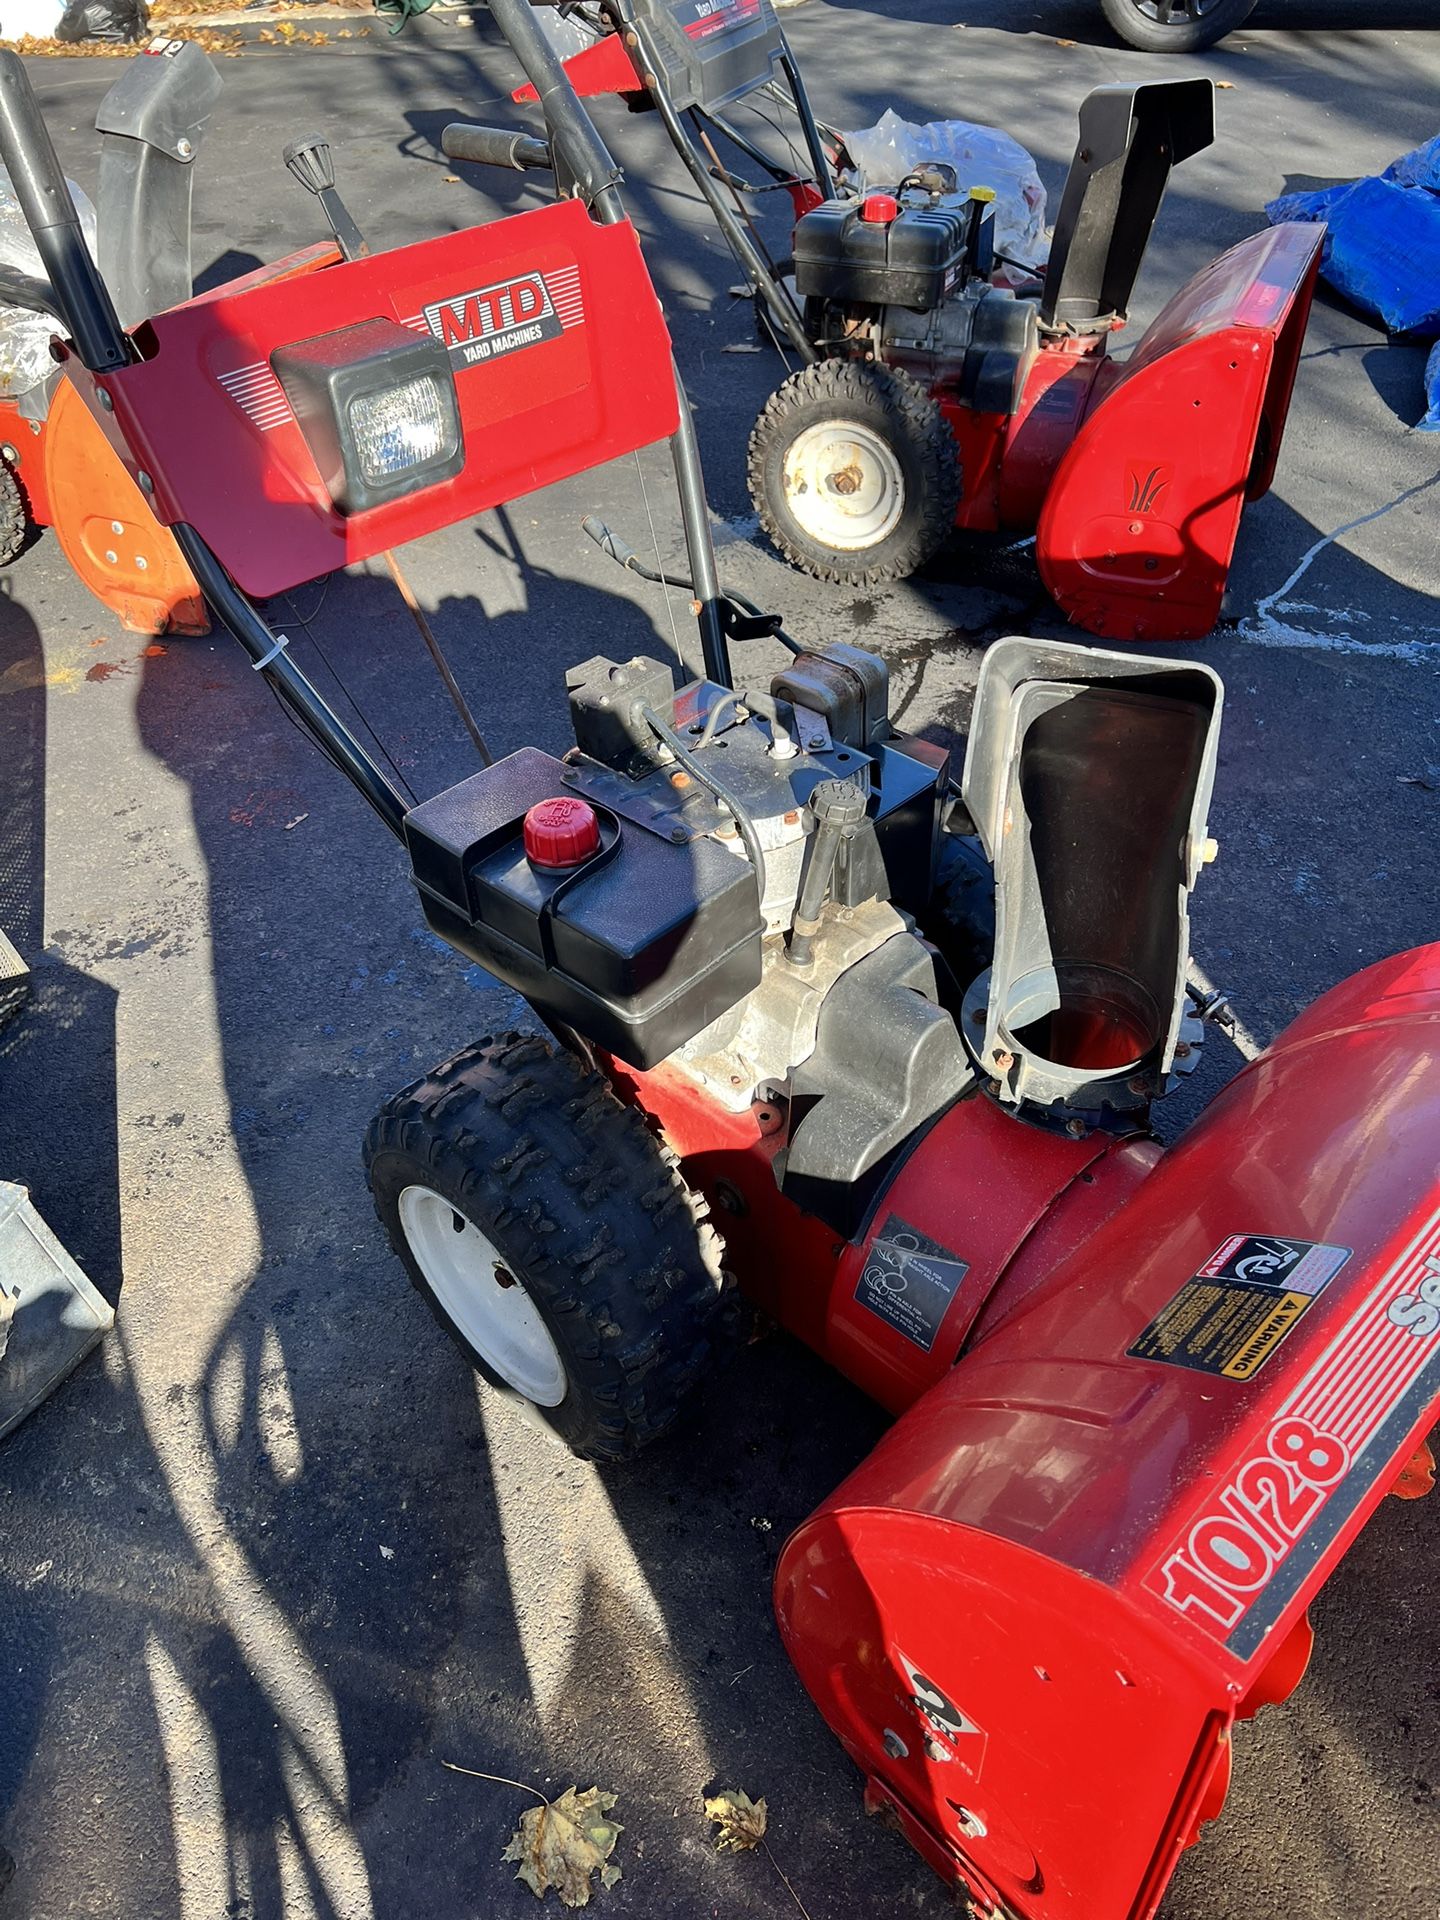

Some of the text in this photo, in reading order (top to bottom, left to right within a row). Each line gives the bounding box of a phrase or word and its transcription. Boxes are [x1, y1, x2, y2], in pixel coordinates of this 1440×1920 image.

[438, 279, 545, 346] MTD
[463, 324, 543, 363] YARD MACHINES
[1212, 1237, 1246, 1266] DANGER
[1232, 1314, 1290, 1372] WARNING
[1160, 1416, 1350, 1629] 10/28
[912, 1696, 958, 1746] STAGE
